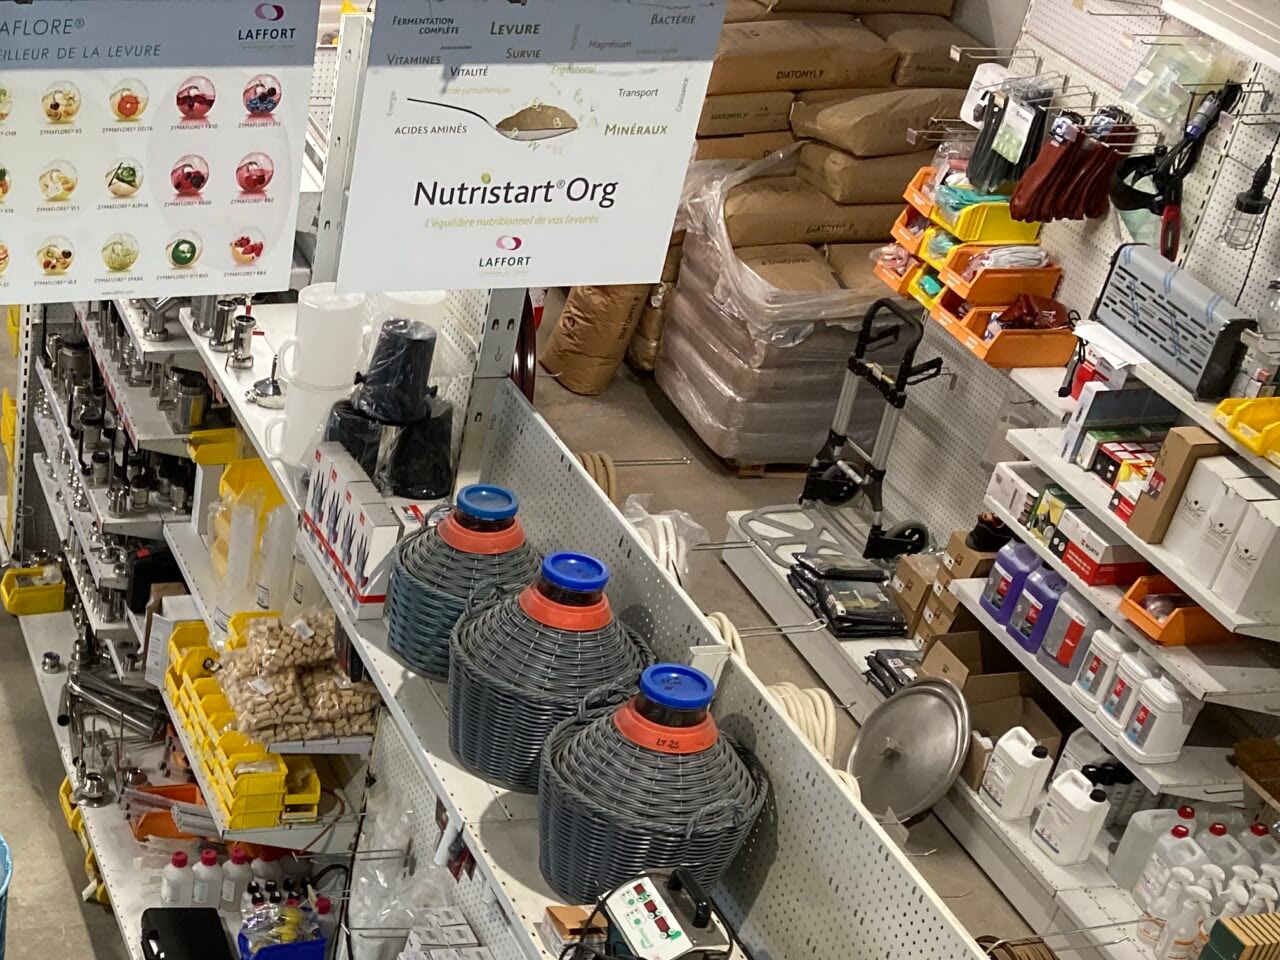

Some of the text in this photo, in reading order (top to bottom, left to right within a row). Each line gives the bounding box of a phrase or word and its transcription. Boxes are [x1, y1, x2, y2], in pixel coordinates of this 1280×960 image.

[392, 16, 454, 26] FERMENTATION
[651, 13, 696, 25] BACTÉRIE
[490, 21, 541, 35] LEVURE
[238, 28, 296, 41] LAFFORT
[57, 46, 76, 60] DE
[83, 46, 100, 59] LA
[108, 44, 161, 58] LEVURE
[505, 48, 541, 59] SURVIE
[387, 54, 441, 65] VITAMINES
[450, 66, 488, 77] VITALITÉ
[776, 69, 819, 80] DIATOMYL
[618, 88, 659, 99] Transport
[394, 123, 467, 135] ACIDES AMINÉS
[604, 123, 668, 136] MINÉRAUX
[476, 214, 533, 227] nutritionnel
[534, 214, 547, 225] de
[565, 213, 599, 224] levures
[479, 256, 531, 267] LAFFORT
[667, 739, 680, 749] 25
